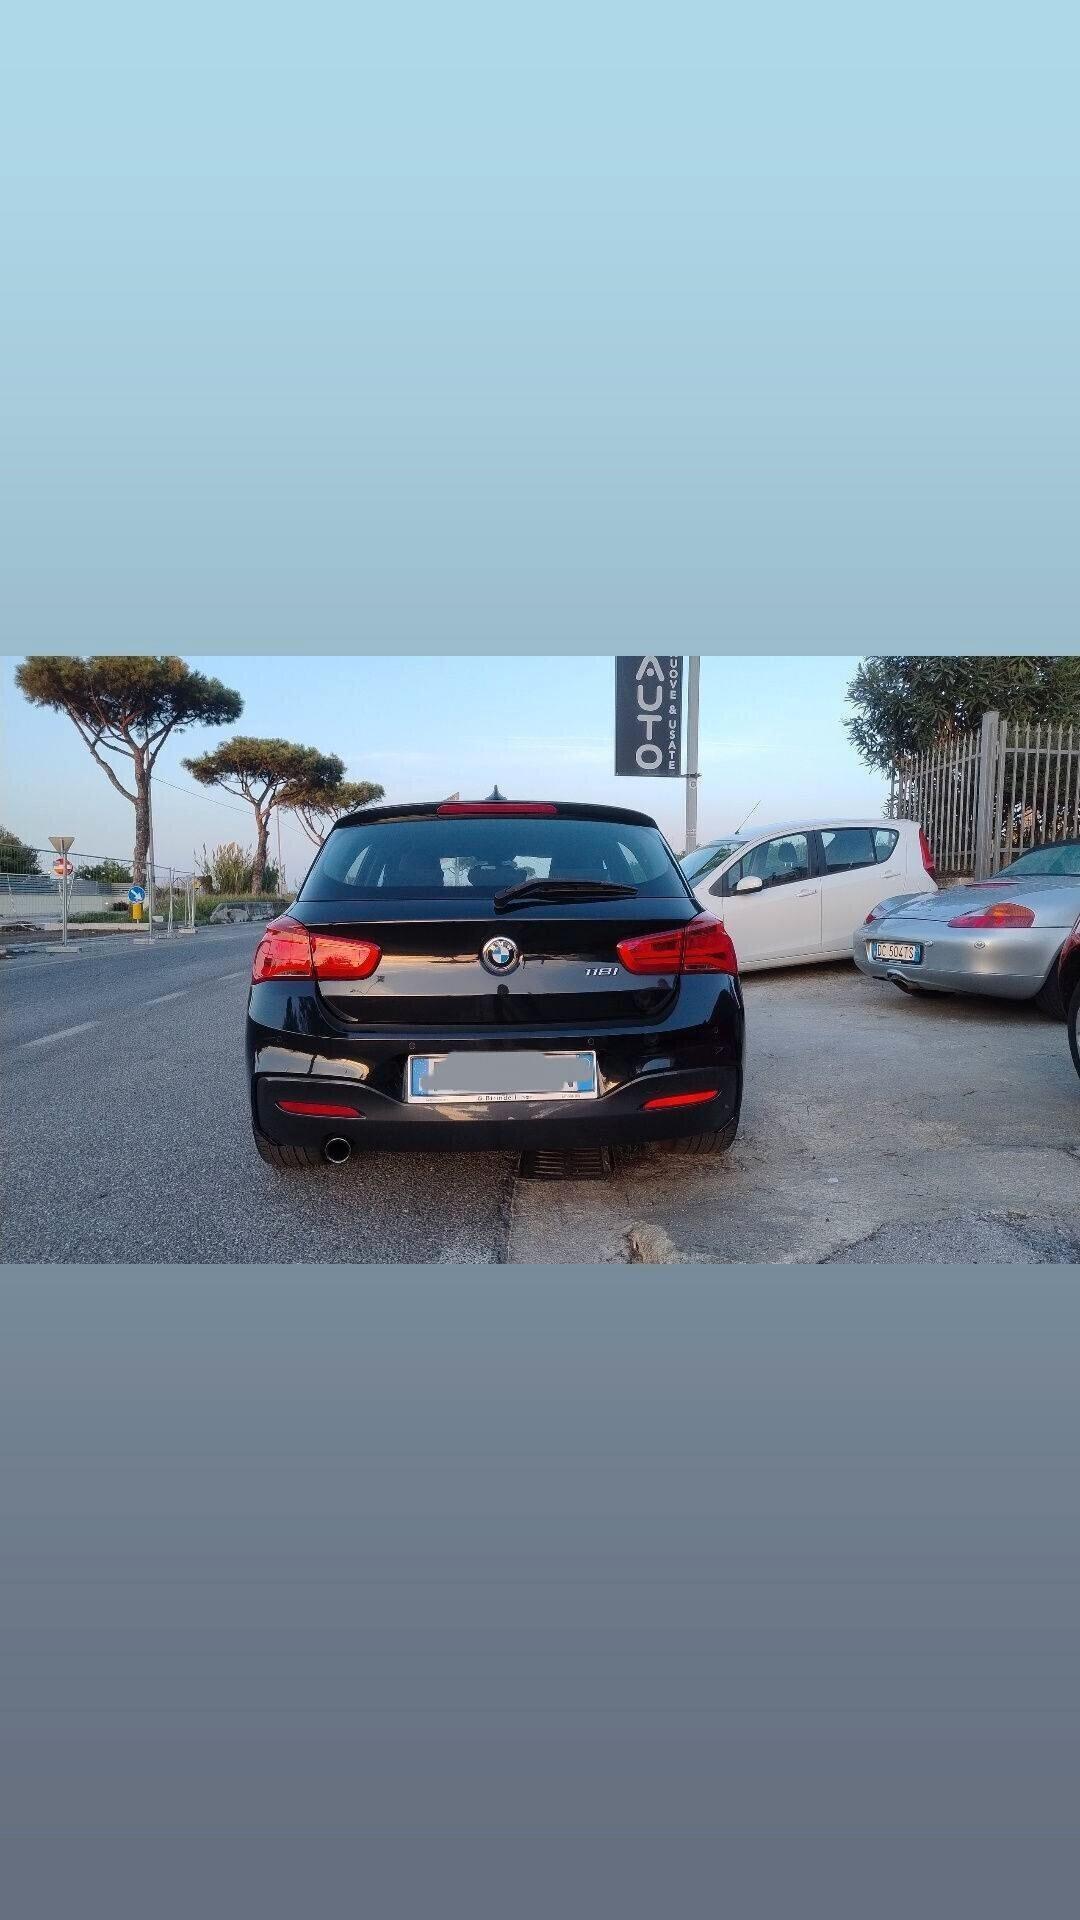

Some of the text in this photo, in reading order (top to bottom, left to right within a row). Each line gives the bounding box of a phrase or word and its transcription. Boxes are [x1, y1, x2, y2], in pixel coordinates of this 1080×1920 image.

[636, 656, 664, 770] AUTO
[668, 656, 678, 770] UOVE & USATE
